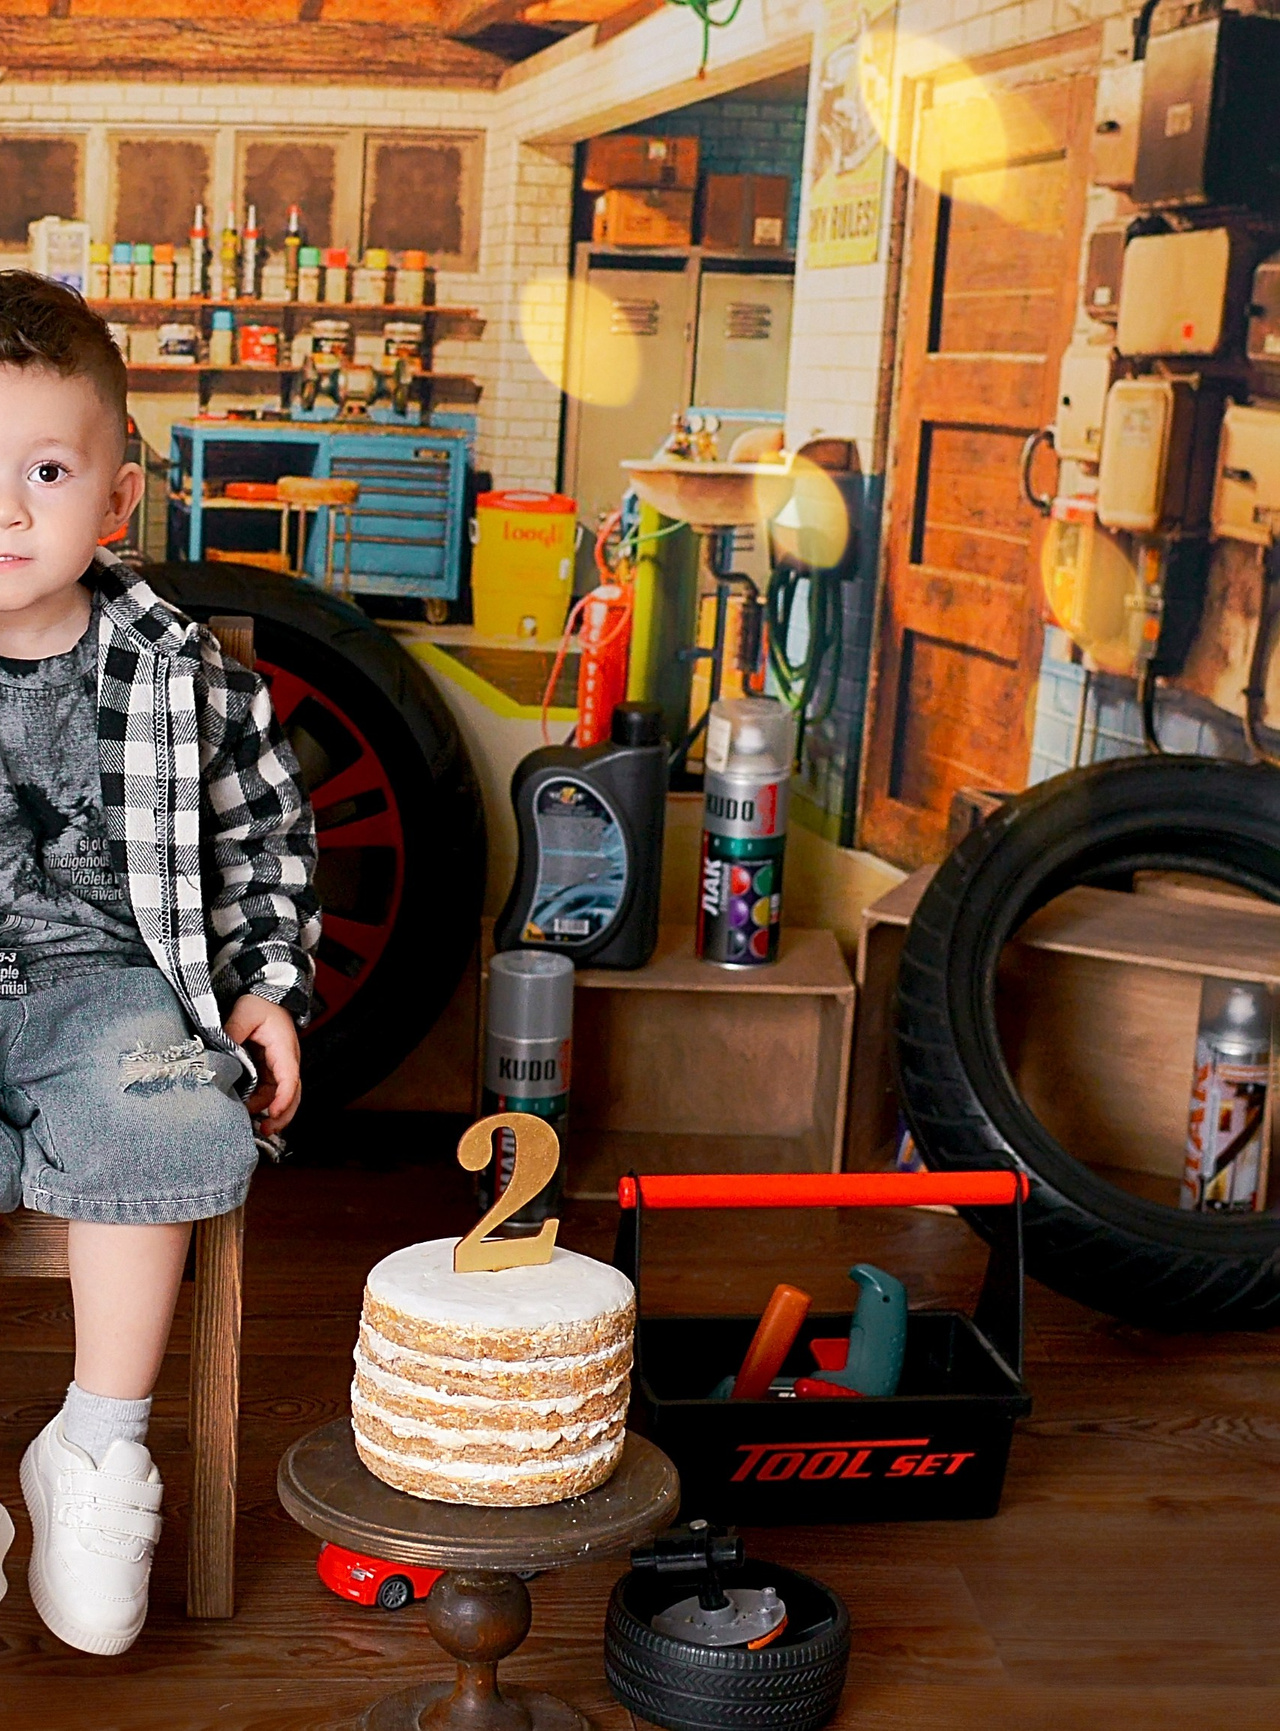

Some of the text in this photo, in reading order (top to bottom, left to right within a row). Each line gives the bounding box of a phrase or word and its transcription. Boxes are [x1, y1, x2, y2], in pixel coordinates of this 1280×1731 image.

[499, 1056, 557, 1082] KUDO
[454, 1112, 561, 1273] 2
[729, 1438, 976, 1482] TOOL SET
